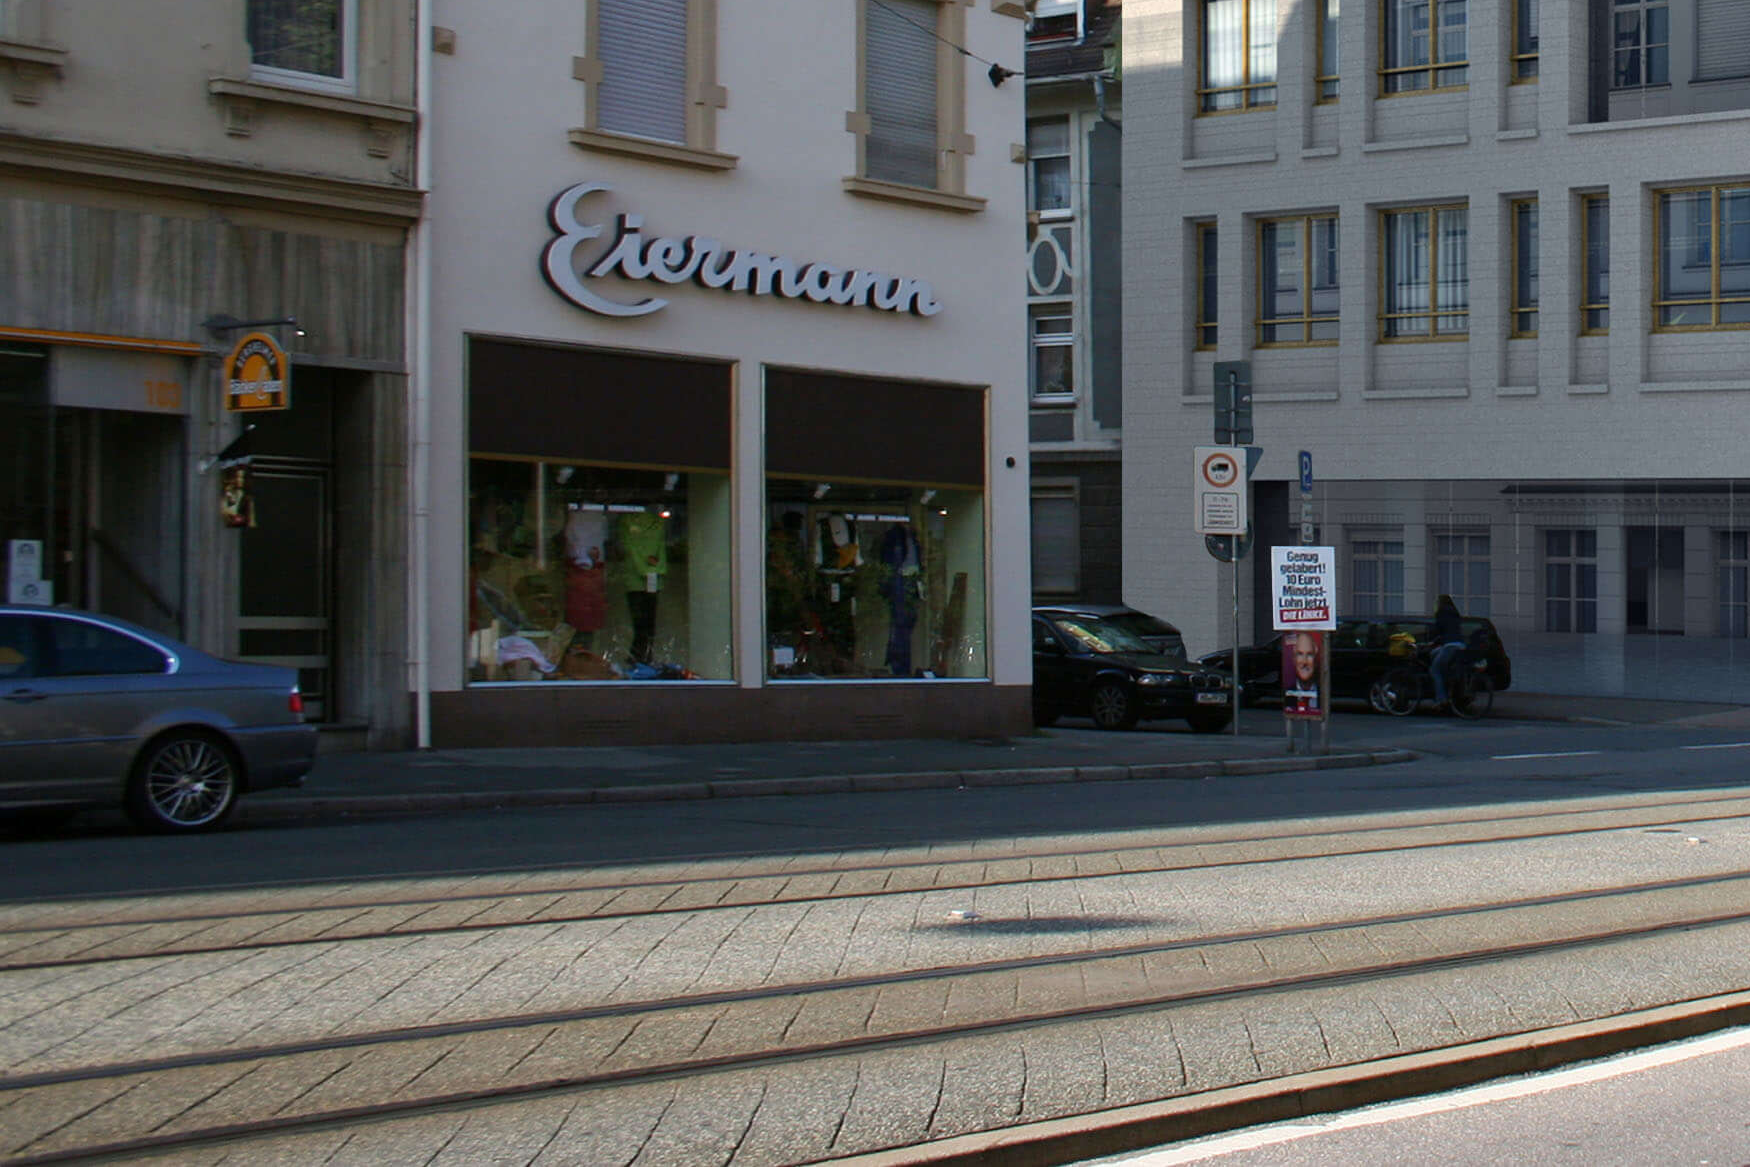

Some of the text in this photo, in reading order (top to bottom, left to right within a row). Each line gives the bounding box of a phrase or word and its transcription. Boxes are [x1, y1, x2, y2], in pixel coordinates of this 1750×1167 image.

[544, 181, 944, 316] Eiermann
[1287, 551, 1319, 564] Genug
[1280, 563, 1326, 575] gelabert!
[1286, 575, 1321, 585] 10 Euro
[1282, 586, 1327, 596] Mindest-
